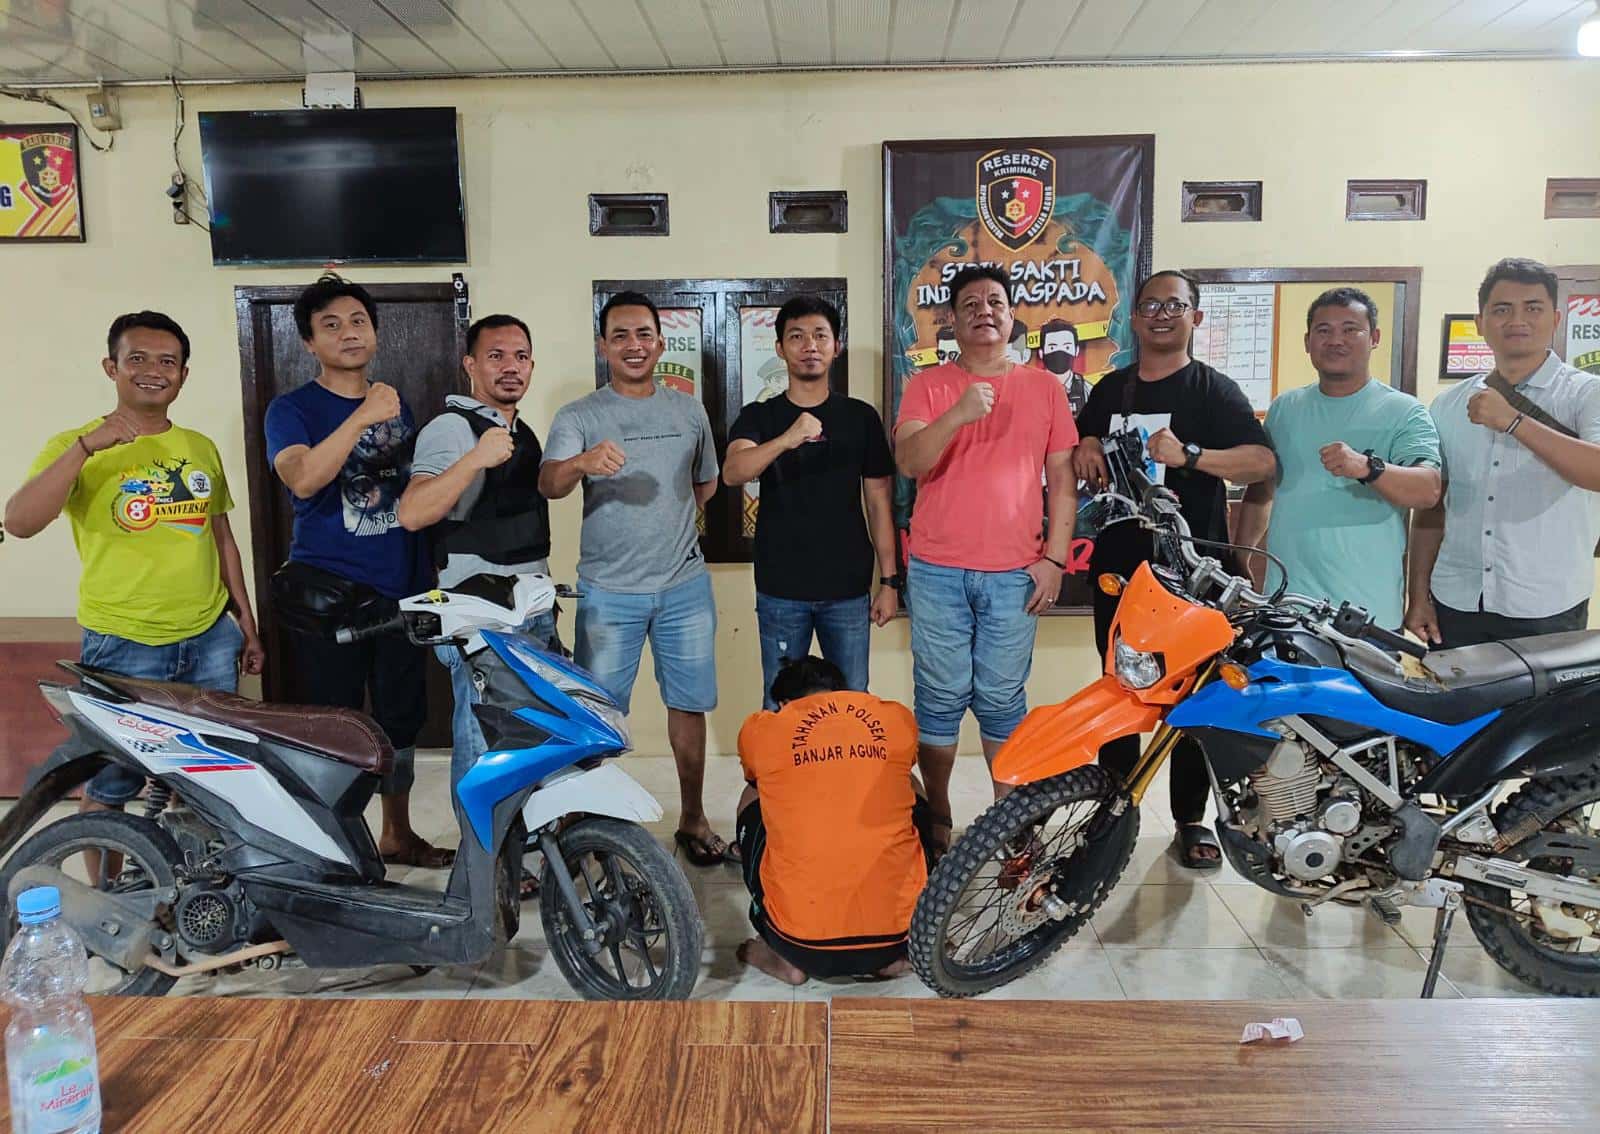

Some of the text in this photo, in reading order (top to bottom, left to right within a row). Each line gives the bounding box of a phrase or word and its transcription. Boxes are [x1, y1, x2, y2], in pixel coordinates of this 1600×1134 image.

[983, 153, 1050, 171] RESERSE
[993, 166, 1038, 177] KRIMINAL
[1010, 259, 1082, 281] SAKTI
[1010, 281, 1107, 305] ASPADA
[791, 701, 888, 750] TAHANAN POLSEK
[793, 744, 887, 766] BANJAR AGUNG
